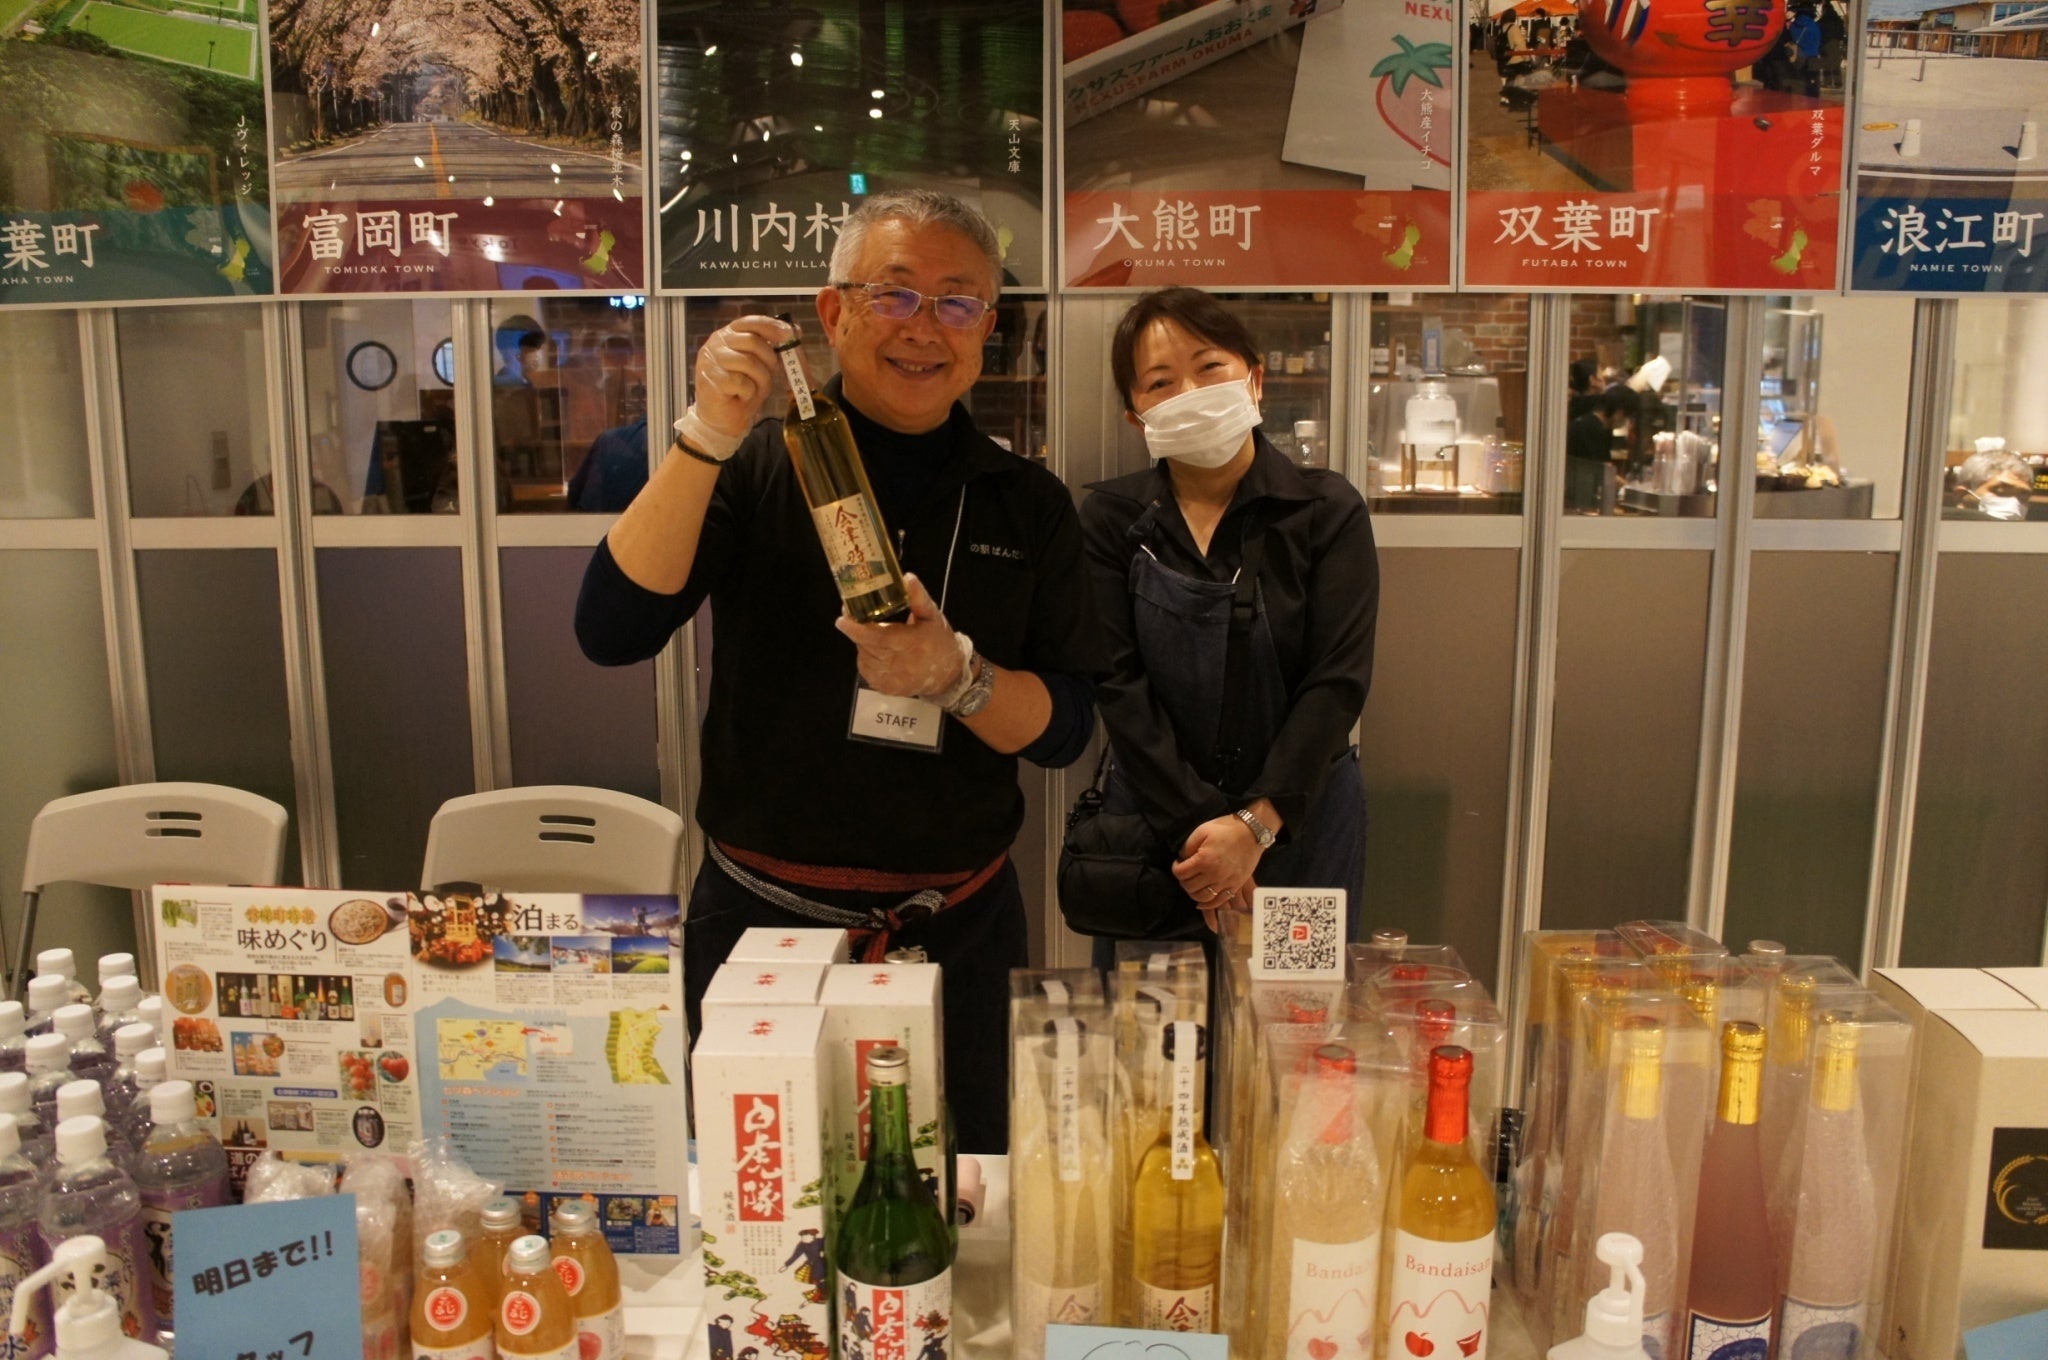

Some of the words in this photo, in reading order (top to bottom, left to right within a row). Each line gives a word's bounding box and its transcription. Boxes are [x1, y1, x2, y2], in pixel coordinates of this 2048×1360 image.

[1192, 28, 1253, 60] OKUMA
[1008, 119, 1021, 173] 天山文庫
[1420, 88, 1434, 170] 大熊産イチゴ
[1809, 109, 1824, 176] 双葉ダルマ
[237, 115, 253, 196] Jヴィレッジ
[0, 219, 99, 271] 葉町
[302, 209, 458, 260] 富岡町
[693, 202, 854, 253] 川内村
[1093, 199, 1261, 252] 大熊町
[1494, 200, 1660, 253] 双葉町
[1881, 204, 2044, 257] 浪江町
[35, 274, 74, 285] TOWN
[324, 265, 387, 275] TOMIOKA
[395, 264, 435, 274] TOWN
[700, 260, 777, 270] KAWAUCHI
[1123, 258, 1178, 268] OKUMA
[1182, 258, 1226, 267] TOWN
[1522, 258, 1578, 268] FUTABA
[1586, 259, 1627, 268] TOWN
[1910, 263, 1954, 272] NAMIE
[1962, 263, 2003, 273] TOWN
[875, 711, 918, 729] STAFF
[237, 927, 327, 952] 味めぐり
[513, 903, 579, 932] 泊まる
[1176, 1066, 1190, 1154] 二十四年熟成酒
[736, 1097, 784, 1218] 白虎隊
